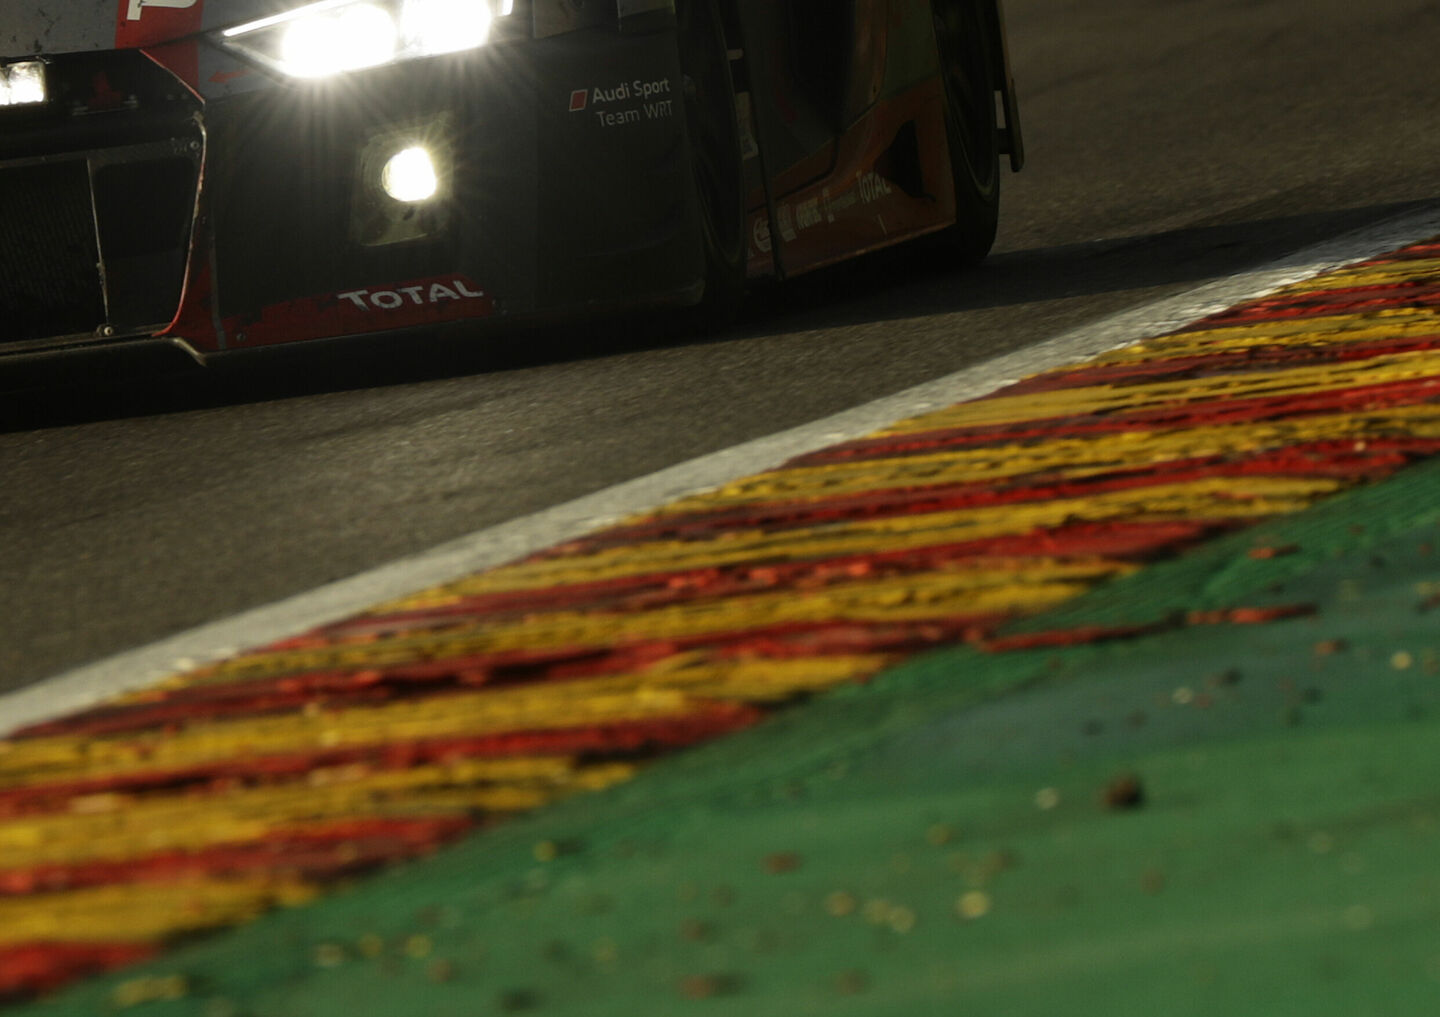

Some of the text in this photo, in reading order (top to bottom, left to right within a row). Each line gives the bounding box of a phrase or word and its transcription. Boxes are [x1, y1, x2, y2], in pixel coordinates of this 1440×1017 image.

[592, 77, 671, 104] Audi Sport
[596, 99, 673, 127] Team WRT
[336, 279, 484, 312] TOTAL
